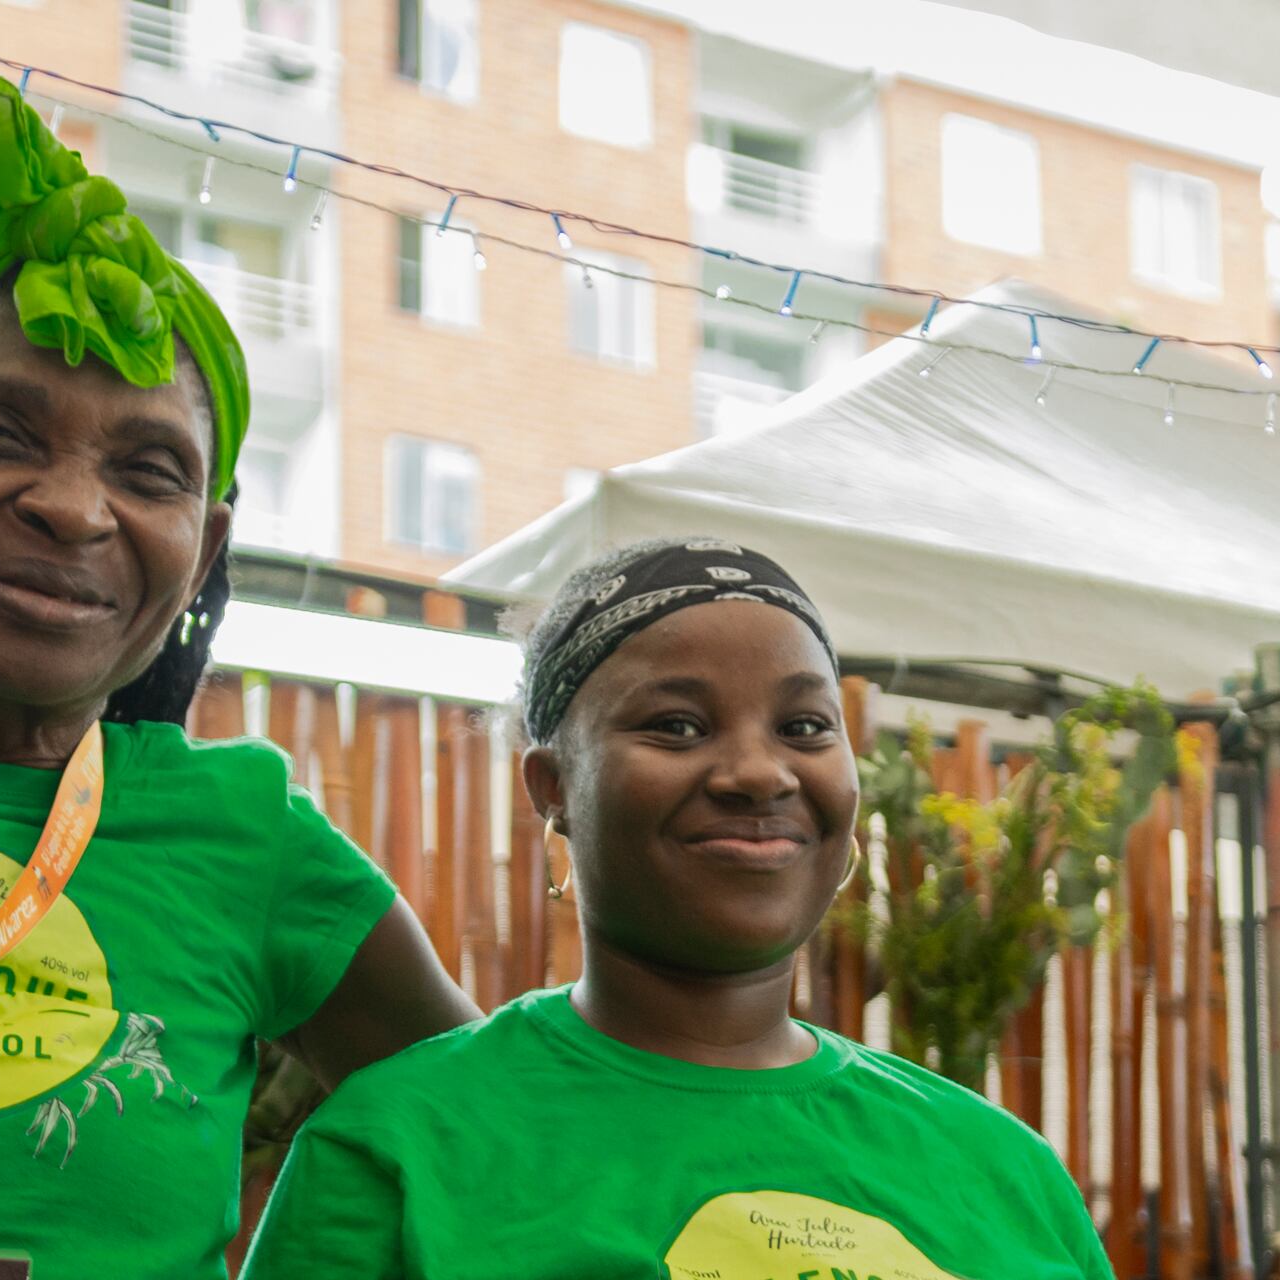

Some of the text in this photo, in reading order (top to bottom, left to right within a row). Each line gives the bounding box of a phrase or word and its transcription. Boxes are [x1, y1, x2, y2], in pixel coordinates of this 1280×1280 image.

[40, 956, 91, 983] 40% vol
[796, 1214, 856, 1236] Julia
[768, 1230, 860, 1251] Hurtado
